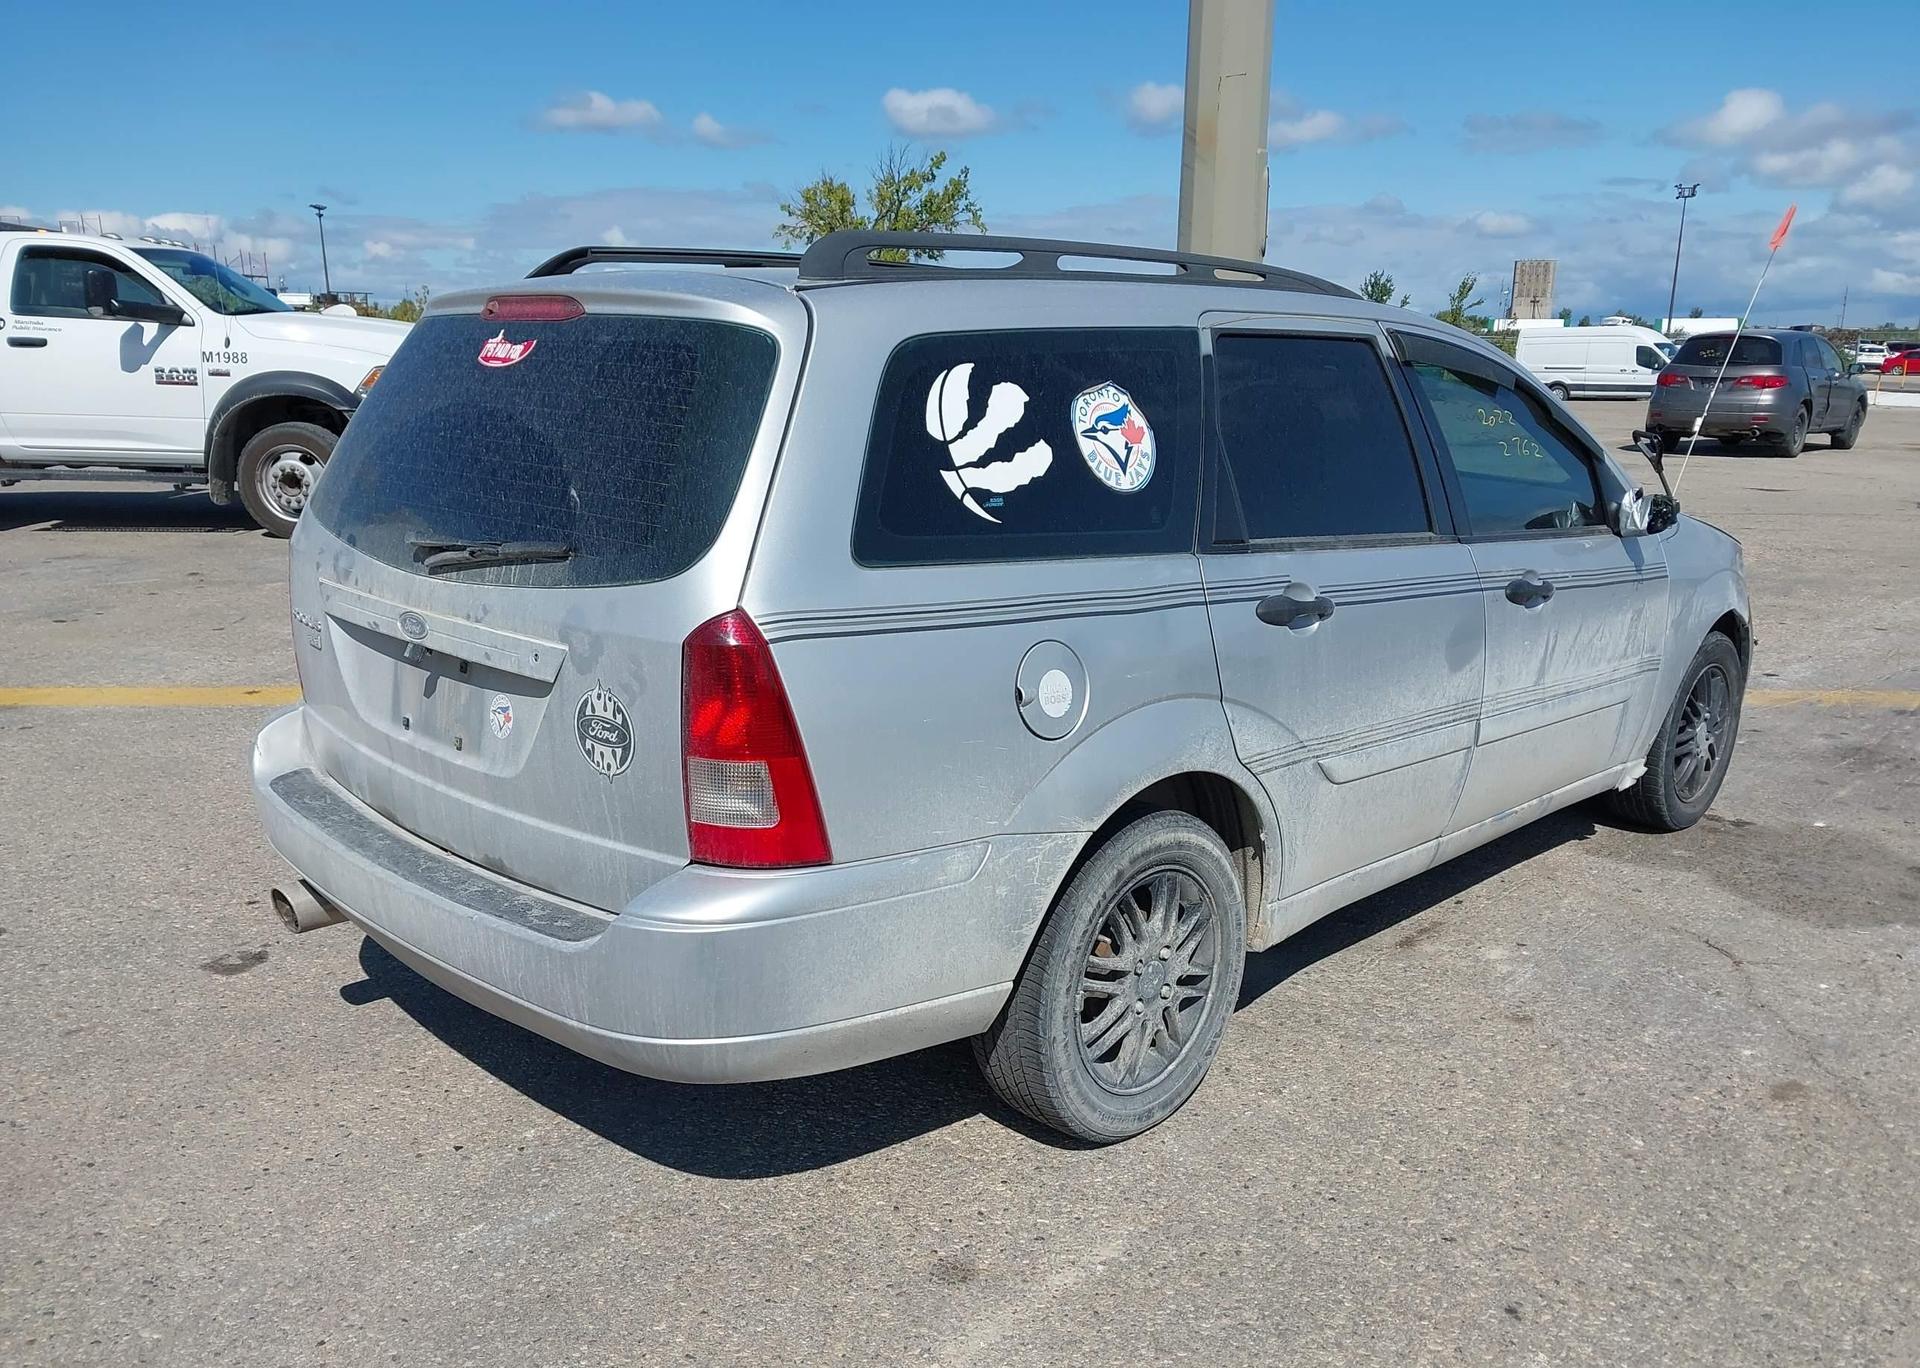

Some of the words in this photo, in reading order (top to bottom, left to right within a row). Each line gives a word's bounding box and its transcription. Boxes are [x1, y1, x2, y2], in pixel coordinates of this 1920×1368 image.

[202, 351, 248, 364] M1988
[154, 367, 197, 375] RAM
[1078, 388, 1121, 424] TORONTO
[1477, 408, 1516, 427] 2022
[1498, 437, 1544, 458] 2762
[1087, 449, 1122, 487] BLUE
[1129, 449, 1150, 486] JAYS
[588, 719, 618, 743] Ford
